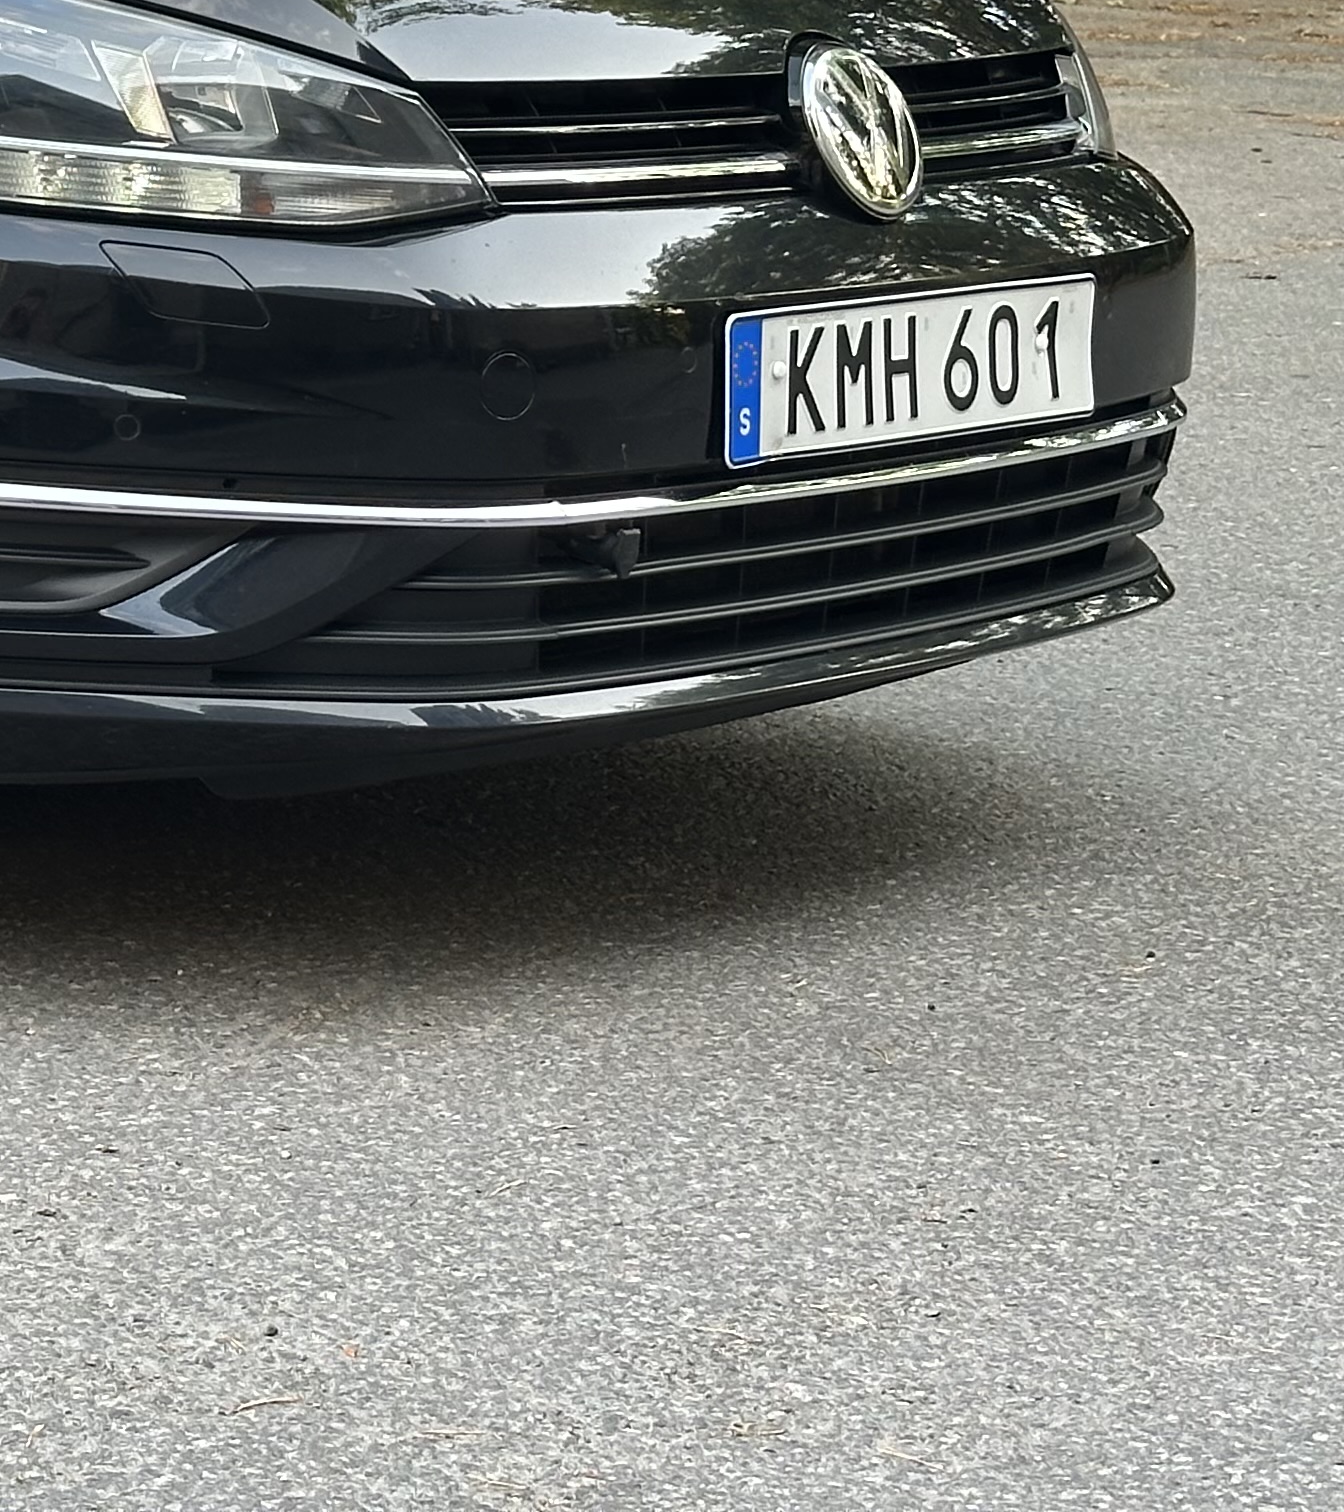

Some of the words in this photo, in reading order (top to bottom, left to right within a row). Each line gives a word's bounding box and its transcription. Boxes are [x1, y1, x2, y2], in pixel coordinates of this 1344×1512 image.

[787, 316, 918, 435] KMH
[944, 299, 1060, 411] 601
[739, 408, 751, 436] S
